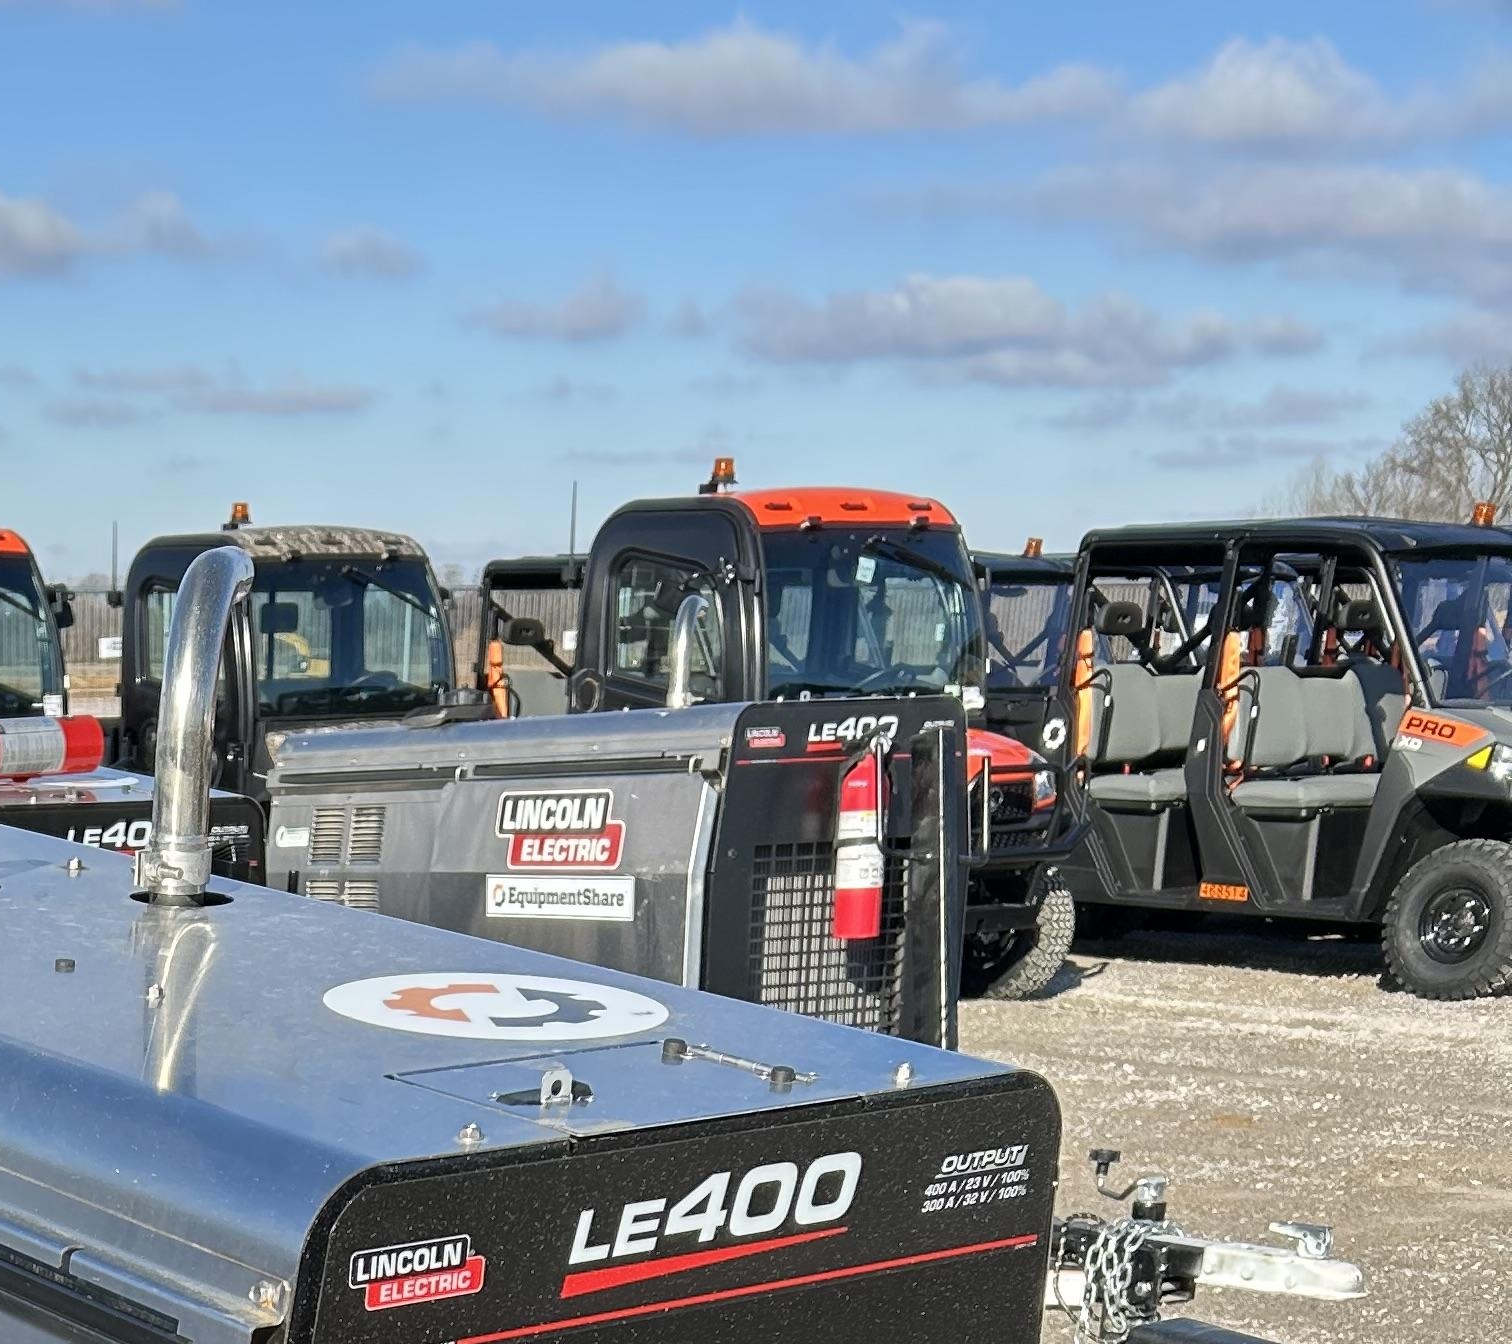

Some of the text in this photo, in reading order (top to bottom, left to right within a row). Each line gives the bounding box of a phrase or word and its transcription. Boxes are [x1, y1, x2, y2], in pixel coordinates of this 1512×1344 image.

[1405, 715, 1456, 740] PRO
[501, 798, 607, 830] LINCOLN
[67, 820, 153, 848] LE40
[520, 838, 612, 863] ELECTRIC
[508, 887, 625, 909] EquipmentShare
[941, 1145, 1023, 1173] OUTPUT
[924, 1182, 948, 1197] 400
[1001, 1168, 1030, 1184] 100%
[568, 1151, 863, 1264] LE400
[921, 1197, 945, 1213] 300
[998, 1184, 1027, 1199] 100%
[356, 1241, 464, 1282] LINCOLN
[379, 1274, 472, 1304] ELECTRIC
